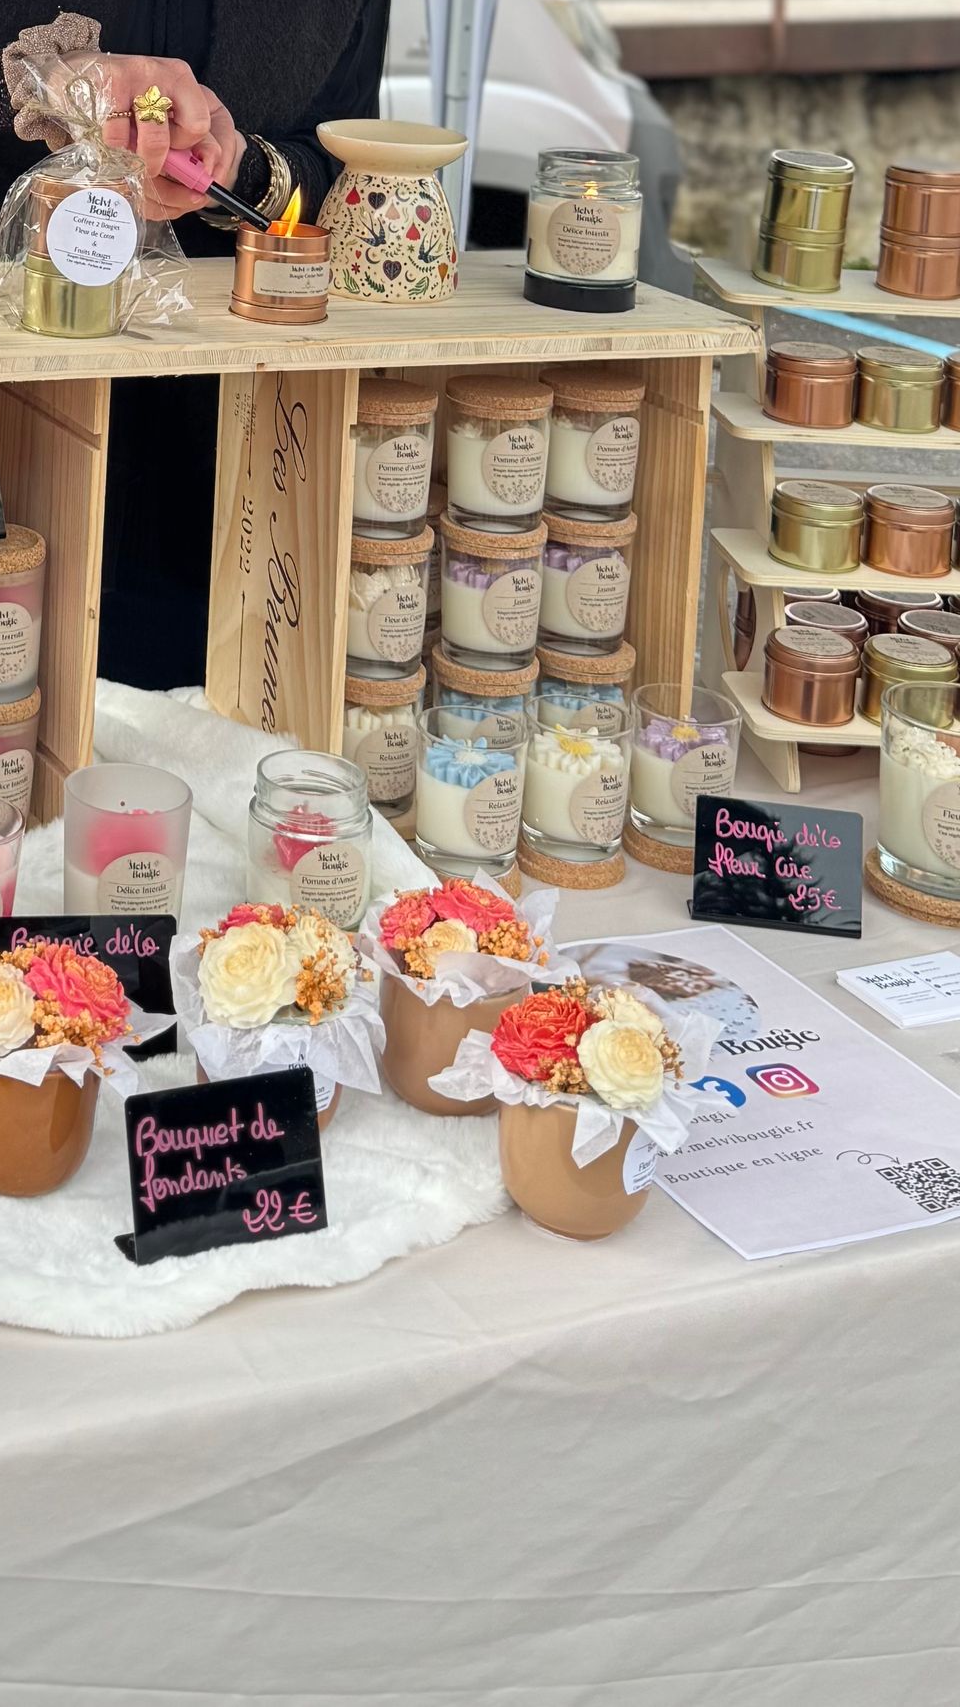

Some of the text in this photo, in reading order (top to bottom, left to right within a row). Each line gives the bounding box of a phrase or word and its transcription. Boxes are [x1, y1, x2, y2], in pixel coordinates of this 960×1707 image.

[239, 495, 255, 574] 2022
[715, 808, 787, 853] Bougie
[301, 876, 330, 885] Pomme
[789, 884, 842, 911] 25€
[716, 1029, 820, 1055] Bougie
[136, 1102, 285, 1160] Bouquet de
[664, 1147, 823, 1184] Boutique en ligne
